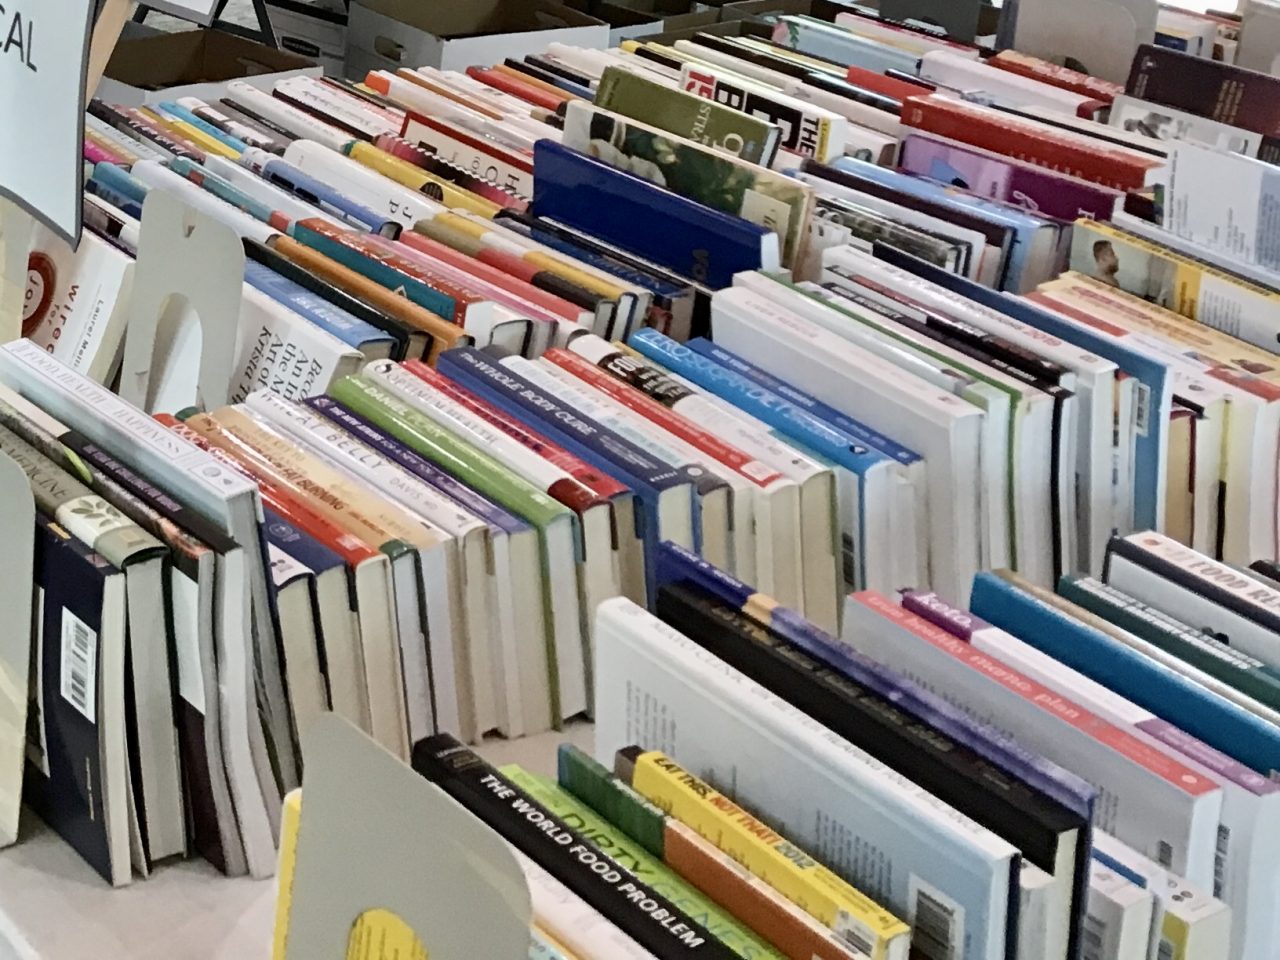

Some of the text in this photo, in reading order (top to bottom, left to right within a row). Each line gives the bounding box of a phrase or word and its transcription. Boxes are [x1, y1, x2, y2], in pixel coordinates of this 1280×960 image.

[46, 303, 61, 327] for
[243, 325, 273, 380] Krista
[257, 333, 287, 389] Art of
[277, 341, 301, 375] the
[292, 349, 311, 379] An
[638, 329, 690, 358] ZERO
[362, 386, 409, 415] DANIEL
[407, 414, 446, 438] PLAN
[474, 361, 525, 392] WHOLE
[518, 388, 560, 413] BODY
[553, 409, 597, 436] CURE
[260, 390, 320, 430] WHEAT
[327, 431, 387, 471] BELLY
[443, 409, 500, 444] HEALTH
[293, 478, 349, 510] BURNING
[388, 477, 422, 500] DAVIS
[1190, 563, 1251, 592] FOOD
[908, 612, 972, 658] healthy
[969, 652, 1032, 692] mama
[1033, 690, 1081, 723] plan
[652, 753, 677, 774] EAT
[708, 794, 739, 819] NOT
[480, 773, 705, 948] THE WORLD FOOD PROBLEM
[558, 812, 655, 877] DIRTY
